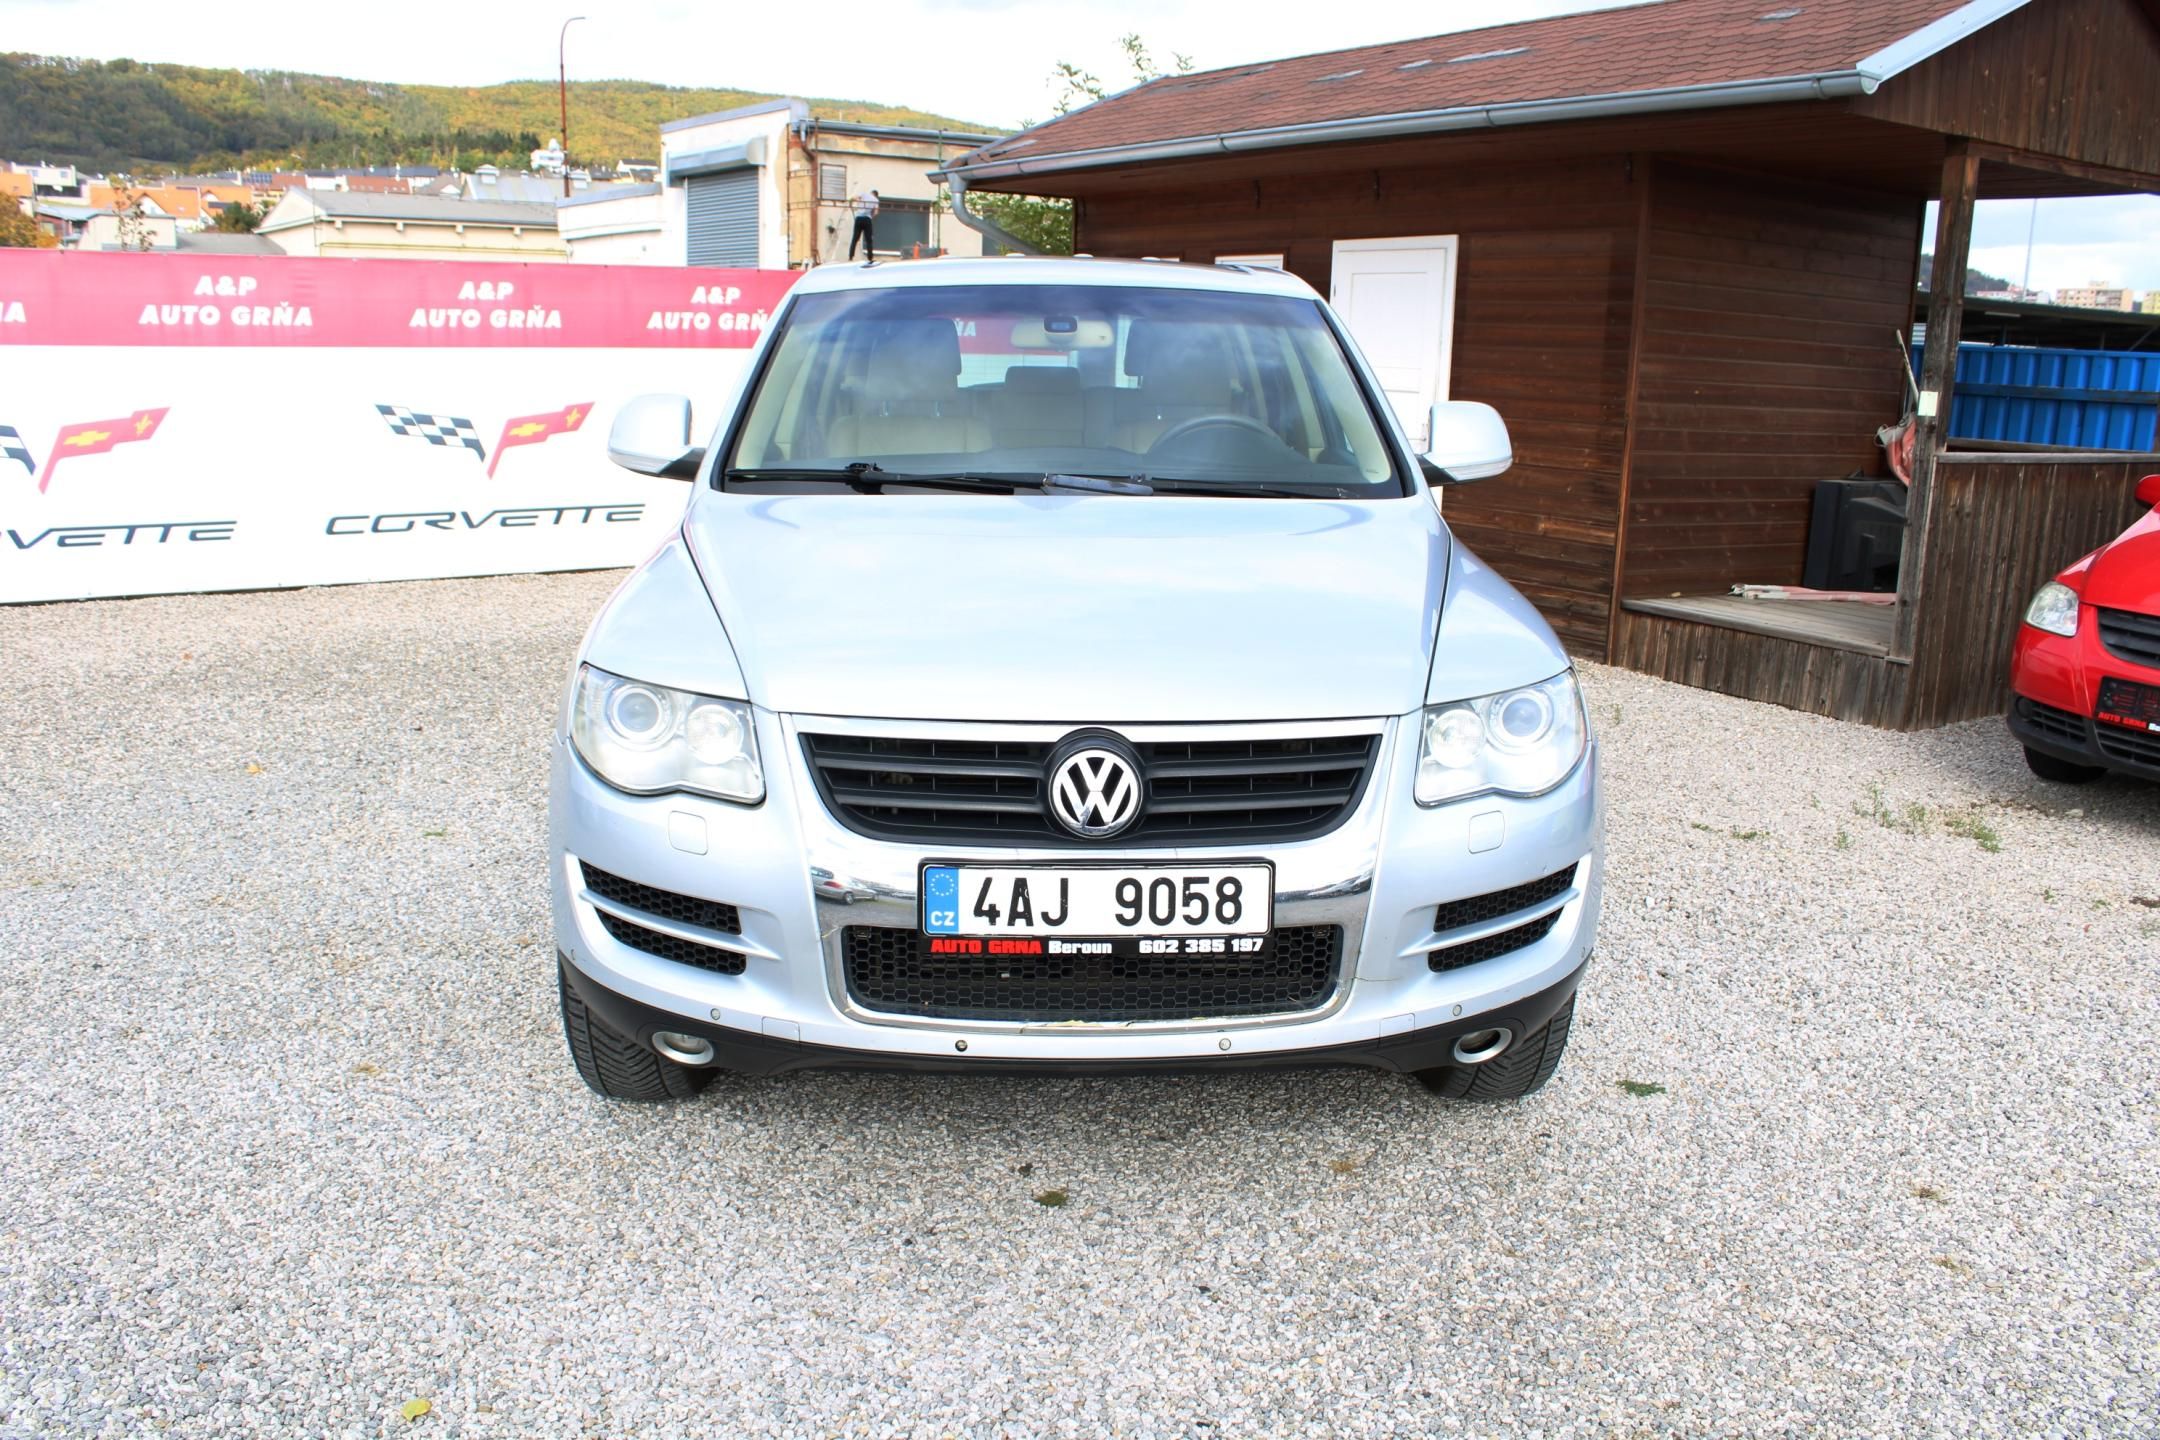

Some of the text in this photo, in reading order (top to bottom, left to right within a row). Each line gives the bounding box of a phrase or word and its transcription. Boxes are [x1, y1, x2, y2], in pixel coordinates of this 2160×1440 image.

[194, 275, 257, 296] A&P
[458, 281, 514, 301] A&P
[690, 286, 741, 304] A&P
[138, 301, 313, 326] AUTO GRŇA
[409, 305, 561, 329] AUTO GRŇA
[646, 309, 768, 331] AUTO GRŇ
[325, 503, 645, 535] CORVETTE
[0, 521, 237, 549] VETTE
[973, 876, 1242, 926] 4AJ 9058
[930, 910, 955, 926] CZ
[930, 938, 1264, 955] AUTO GRNA Beroun 602 385 197
